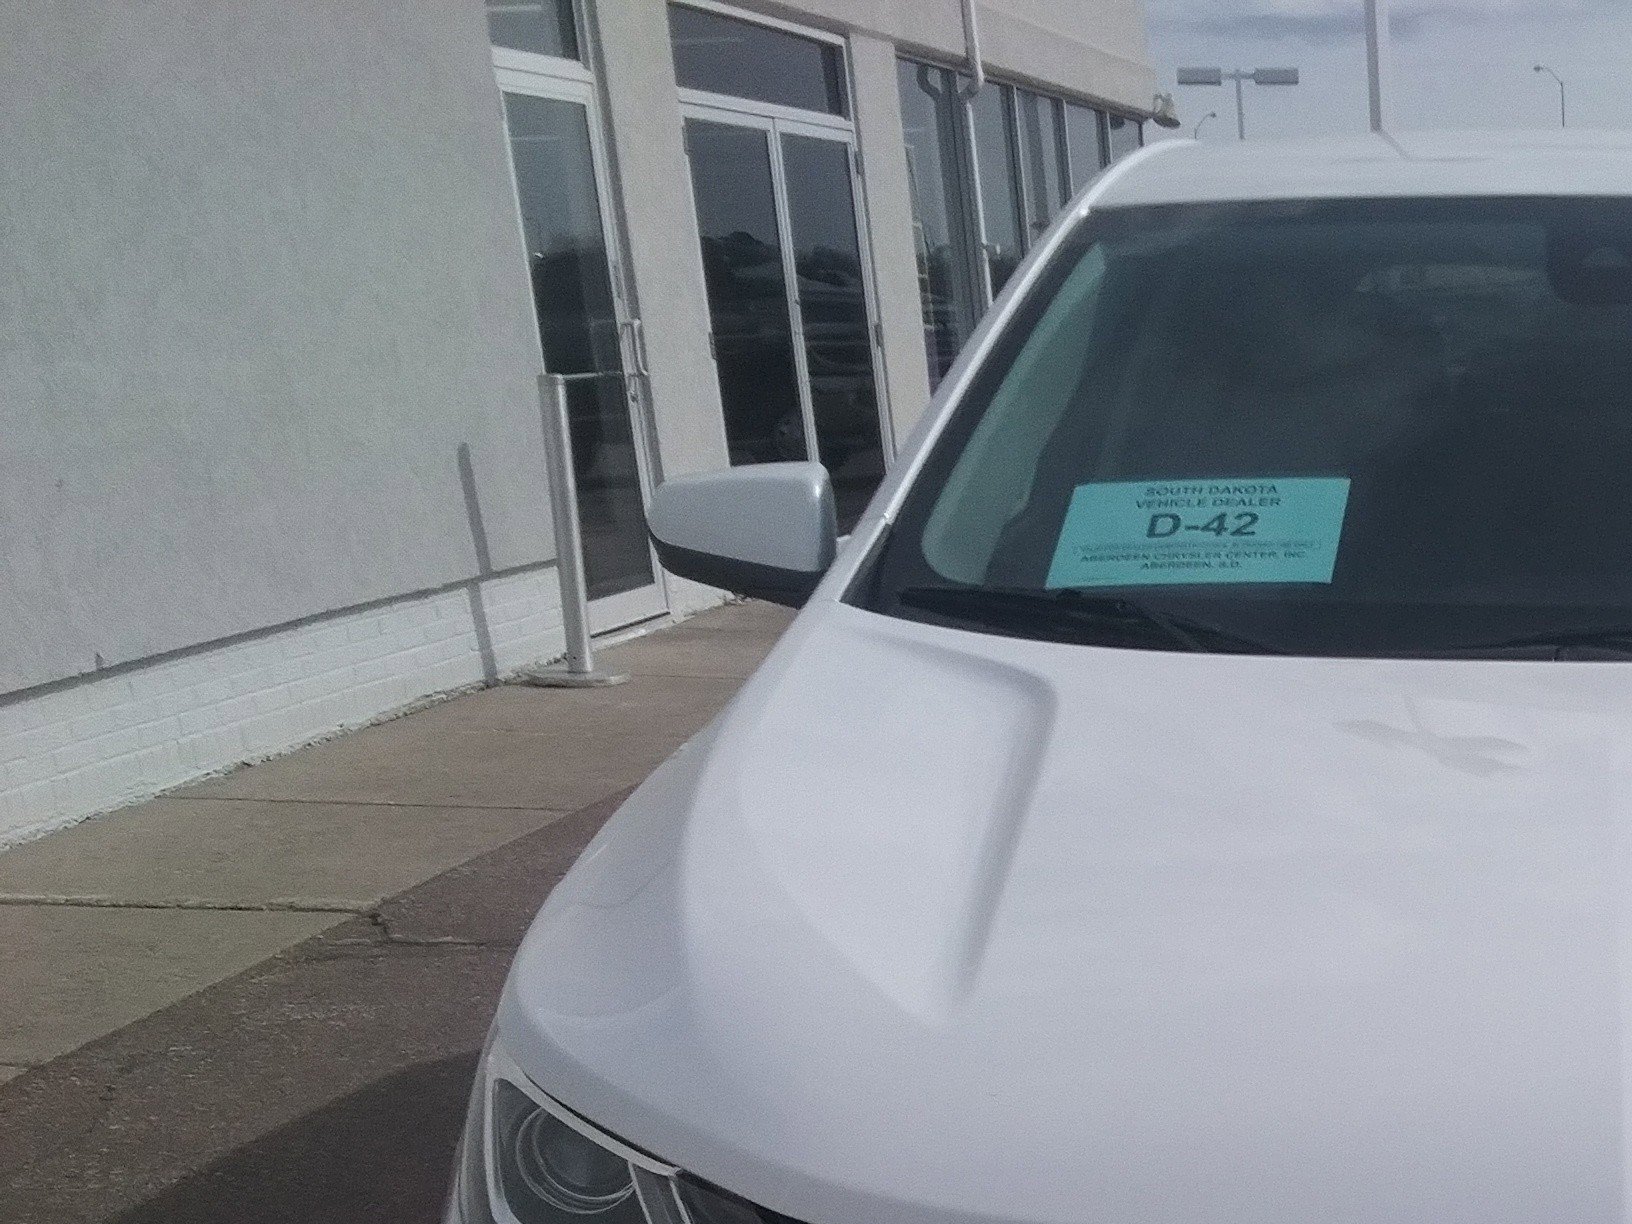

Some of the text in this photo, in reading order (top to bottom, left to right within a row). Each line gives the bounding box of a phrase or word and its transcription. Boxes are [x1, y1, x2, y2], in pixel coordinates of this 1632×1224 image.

[1144, 484, 1278, 496] SOUTH DAKOTA
[1136, 496, 1282, 509] VEHICLE DEALER
[1146, 511, 1260, 539] D-42
